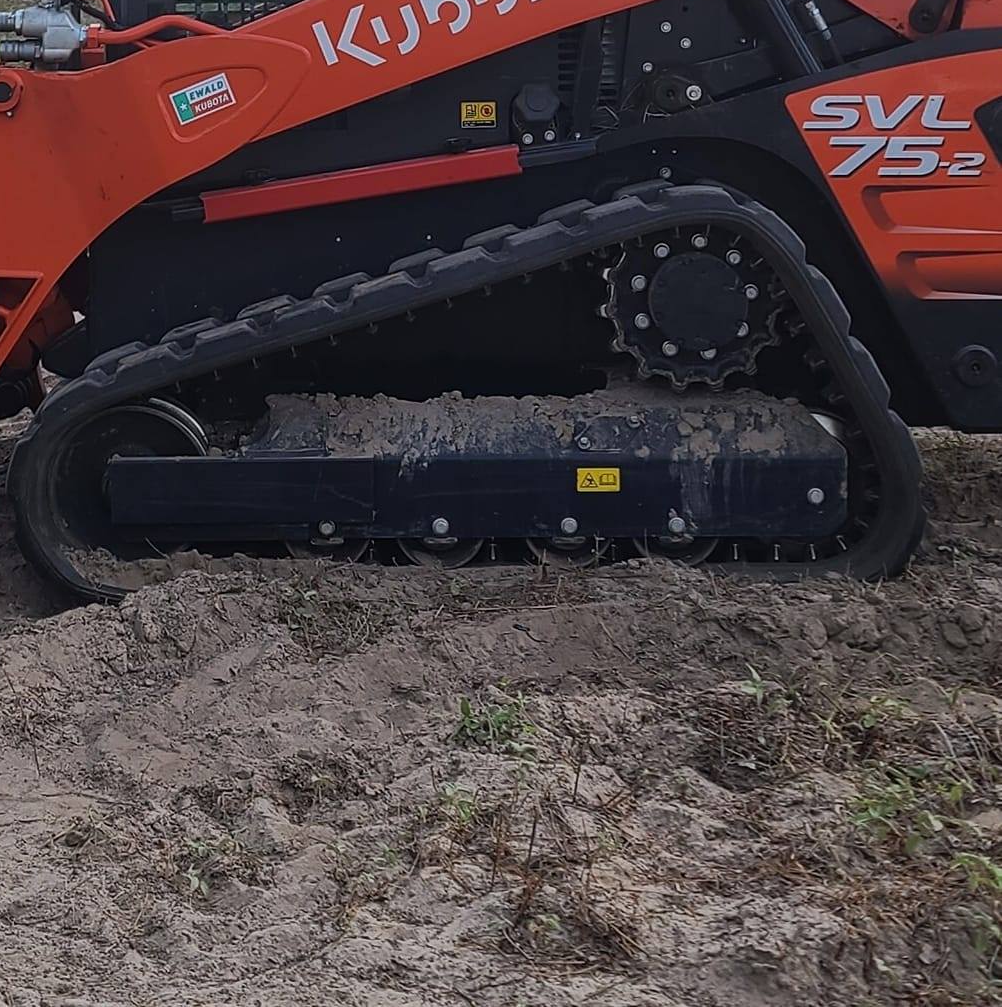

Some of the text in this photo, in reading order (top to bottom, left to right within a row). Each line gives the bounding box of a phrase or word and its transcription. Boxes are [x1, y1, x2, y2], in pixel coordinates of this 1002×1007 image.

[189, 80, 224, 101] EWALD
[194, 93, 230, 113] KUBOTA
[802, 95, 972, 129] SVL
[827, 136, 986, 176] 75-2
